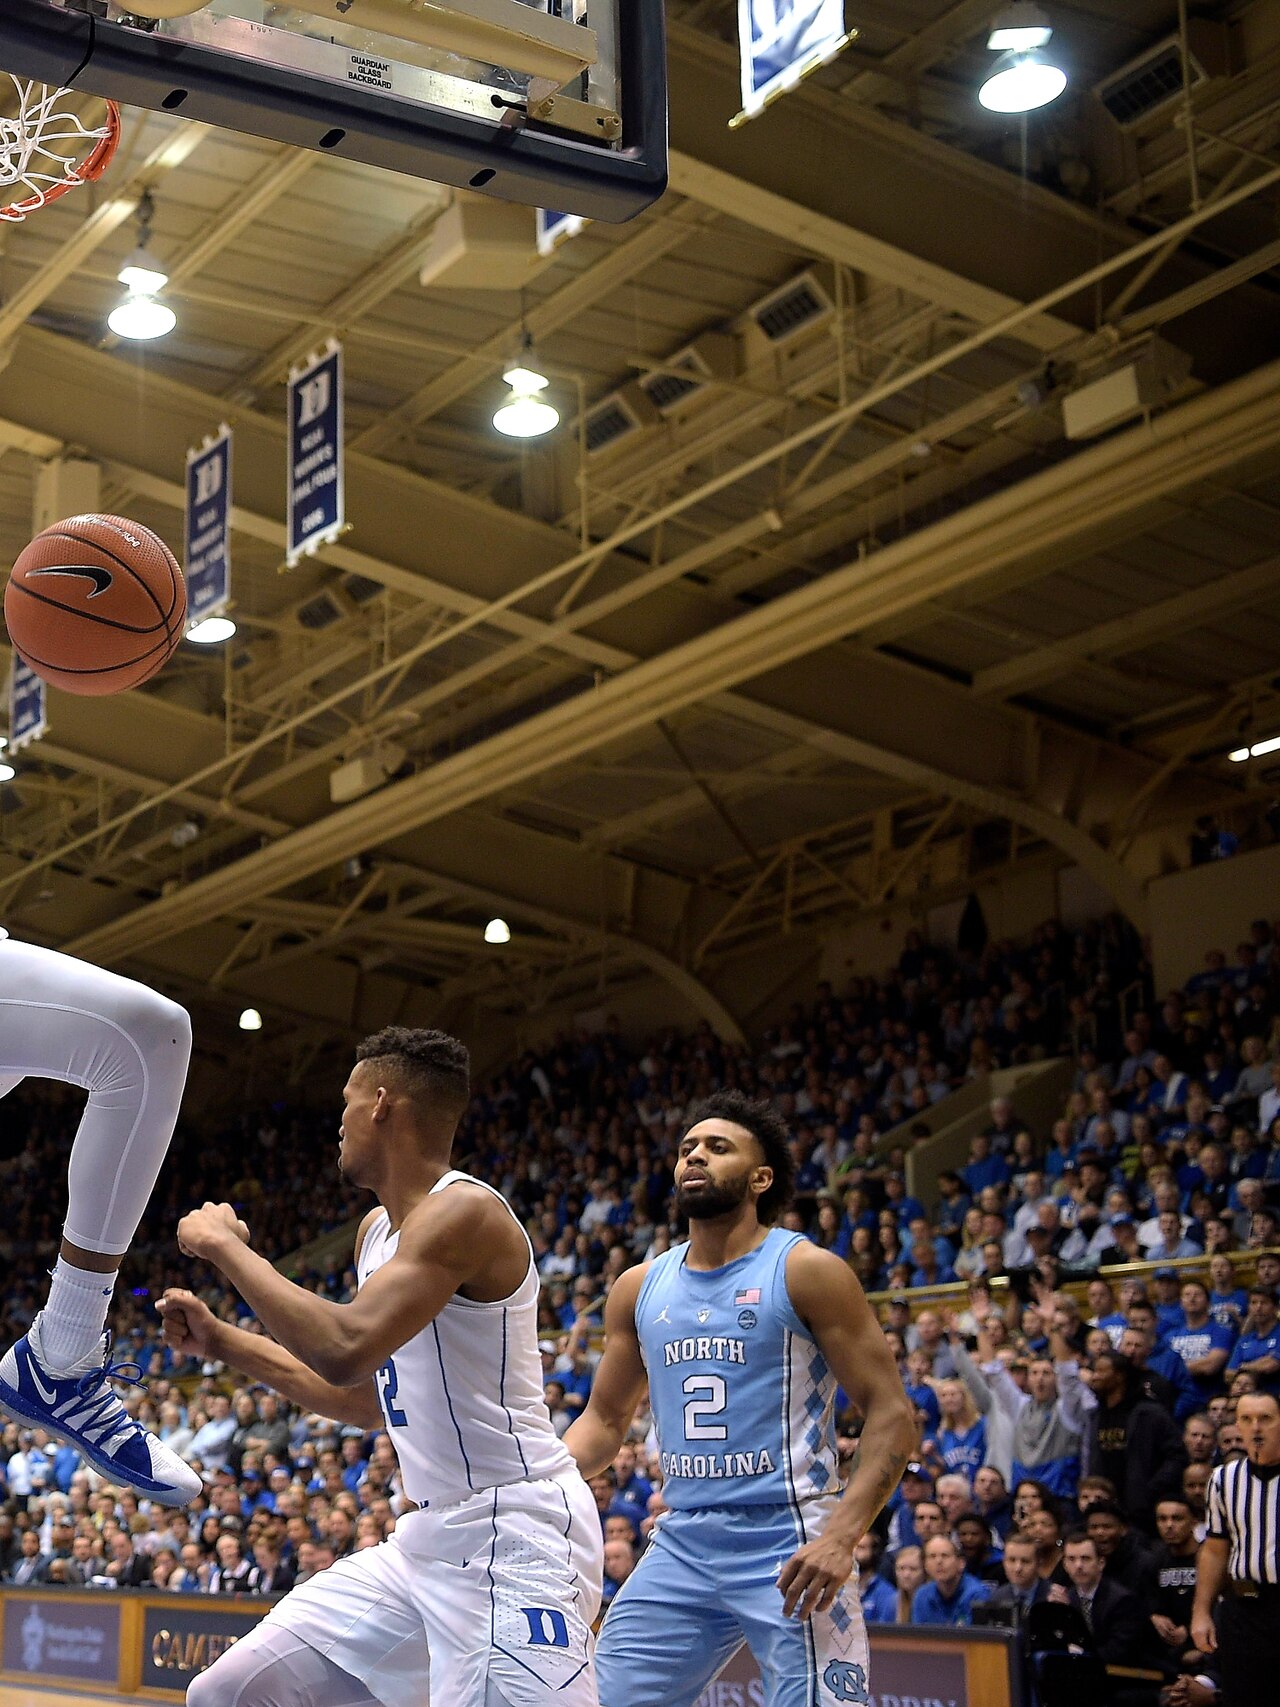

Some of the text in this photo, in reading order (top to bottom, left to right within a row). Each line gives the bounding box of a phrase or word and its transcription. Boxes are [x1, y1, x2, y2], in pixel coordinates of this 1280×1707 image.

[351, 55, 390, 72] GUARDIAN
[357, 66, 382, 79] GLASS
[348, 72, 392, 90] BACKBOARD
[664, 1336, 747, 1367] NORTH
[682, 1374, 728, 1442] 2
[662, 1448, 776, 1480] CAROLINA
